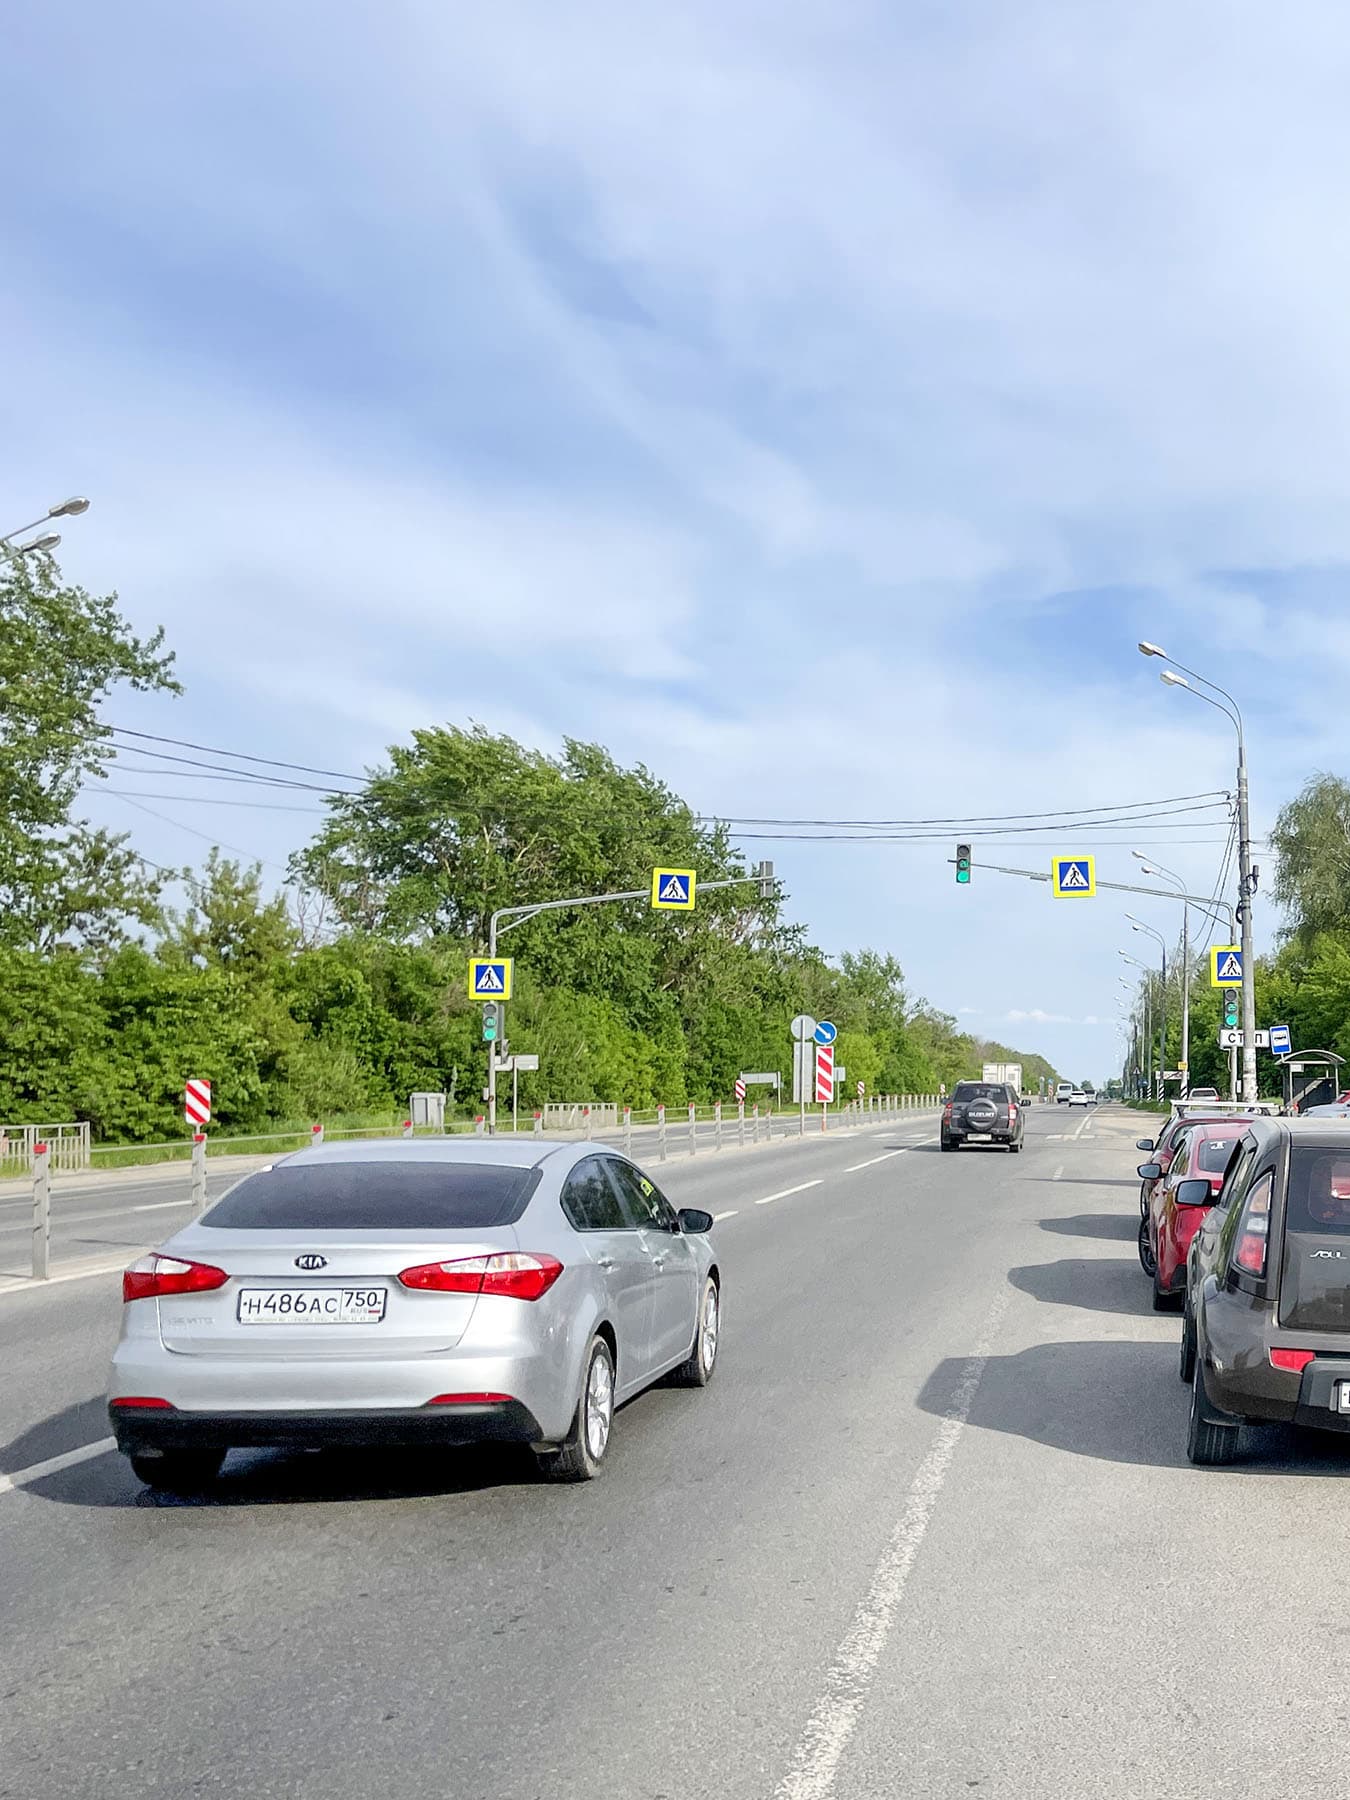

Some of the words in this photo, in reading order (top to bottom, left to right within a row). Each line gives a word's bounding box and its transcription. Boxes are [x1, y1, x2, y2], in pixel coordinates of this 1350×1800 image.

[1228, 1033, 1262, 1044] СТП
[298, 1256, 323, 1269] KIA
[344, 1292, 378, 1307] 750
